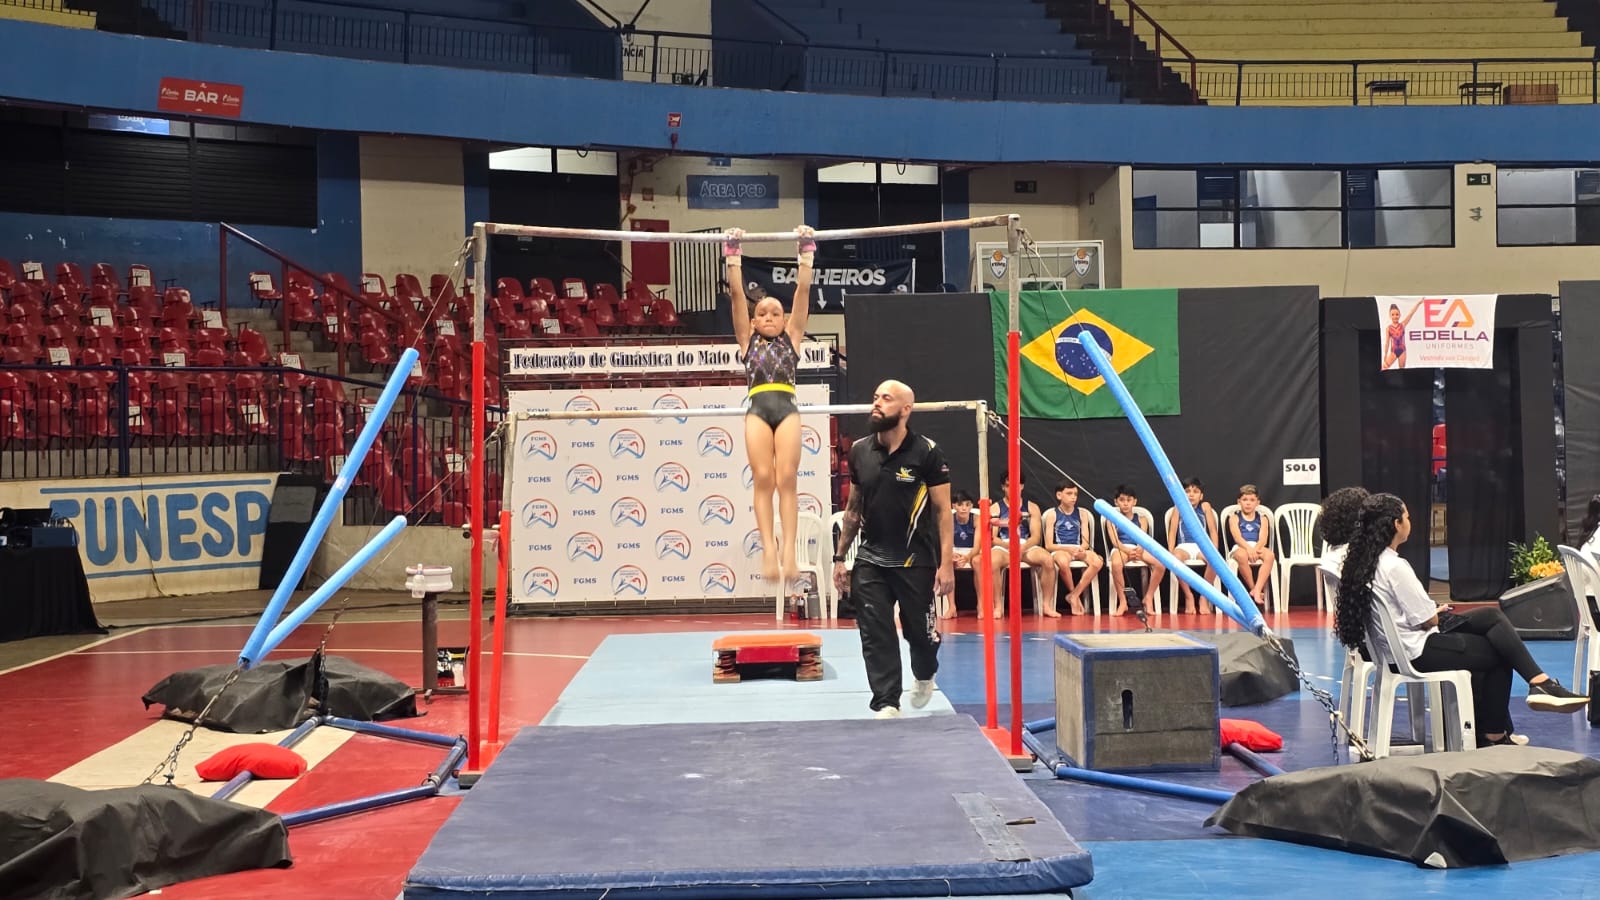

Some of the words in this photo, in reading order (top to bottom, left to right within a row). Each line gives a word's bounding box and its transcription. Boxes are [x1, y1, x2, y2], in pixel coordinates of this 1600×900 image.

[184, 89, 218, 104] BAR
[700, 180, 736, 197] ÁREA
[737, 183, 767, 197] PCD
[772, 266, 886, 286] BAHEIROS
[1409, 330, 1489, 341] EDELLA
[1425, 342, 1474, 350] UNIFORMES
[513, 352, 586, 370] Federação
[588, 352, 606, 368] de
[610, 350, 673, 368] Ginástica
[677, 350, 694, 366] do
[699, 350, 730, 365] Mato
[1285, 463, 1317, 472] SOLO
